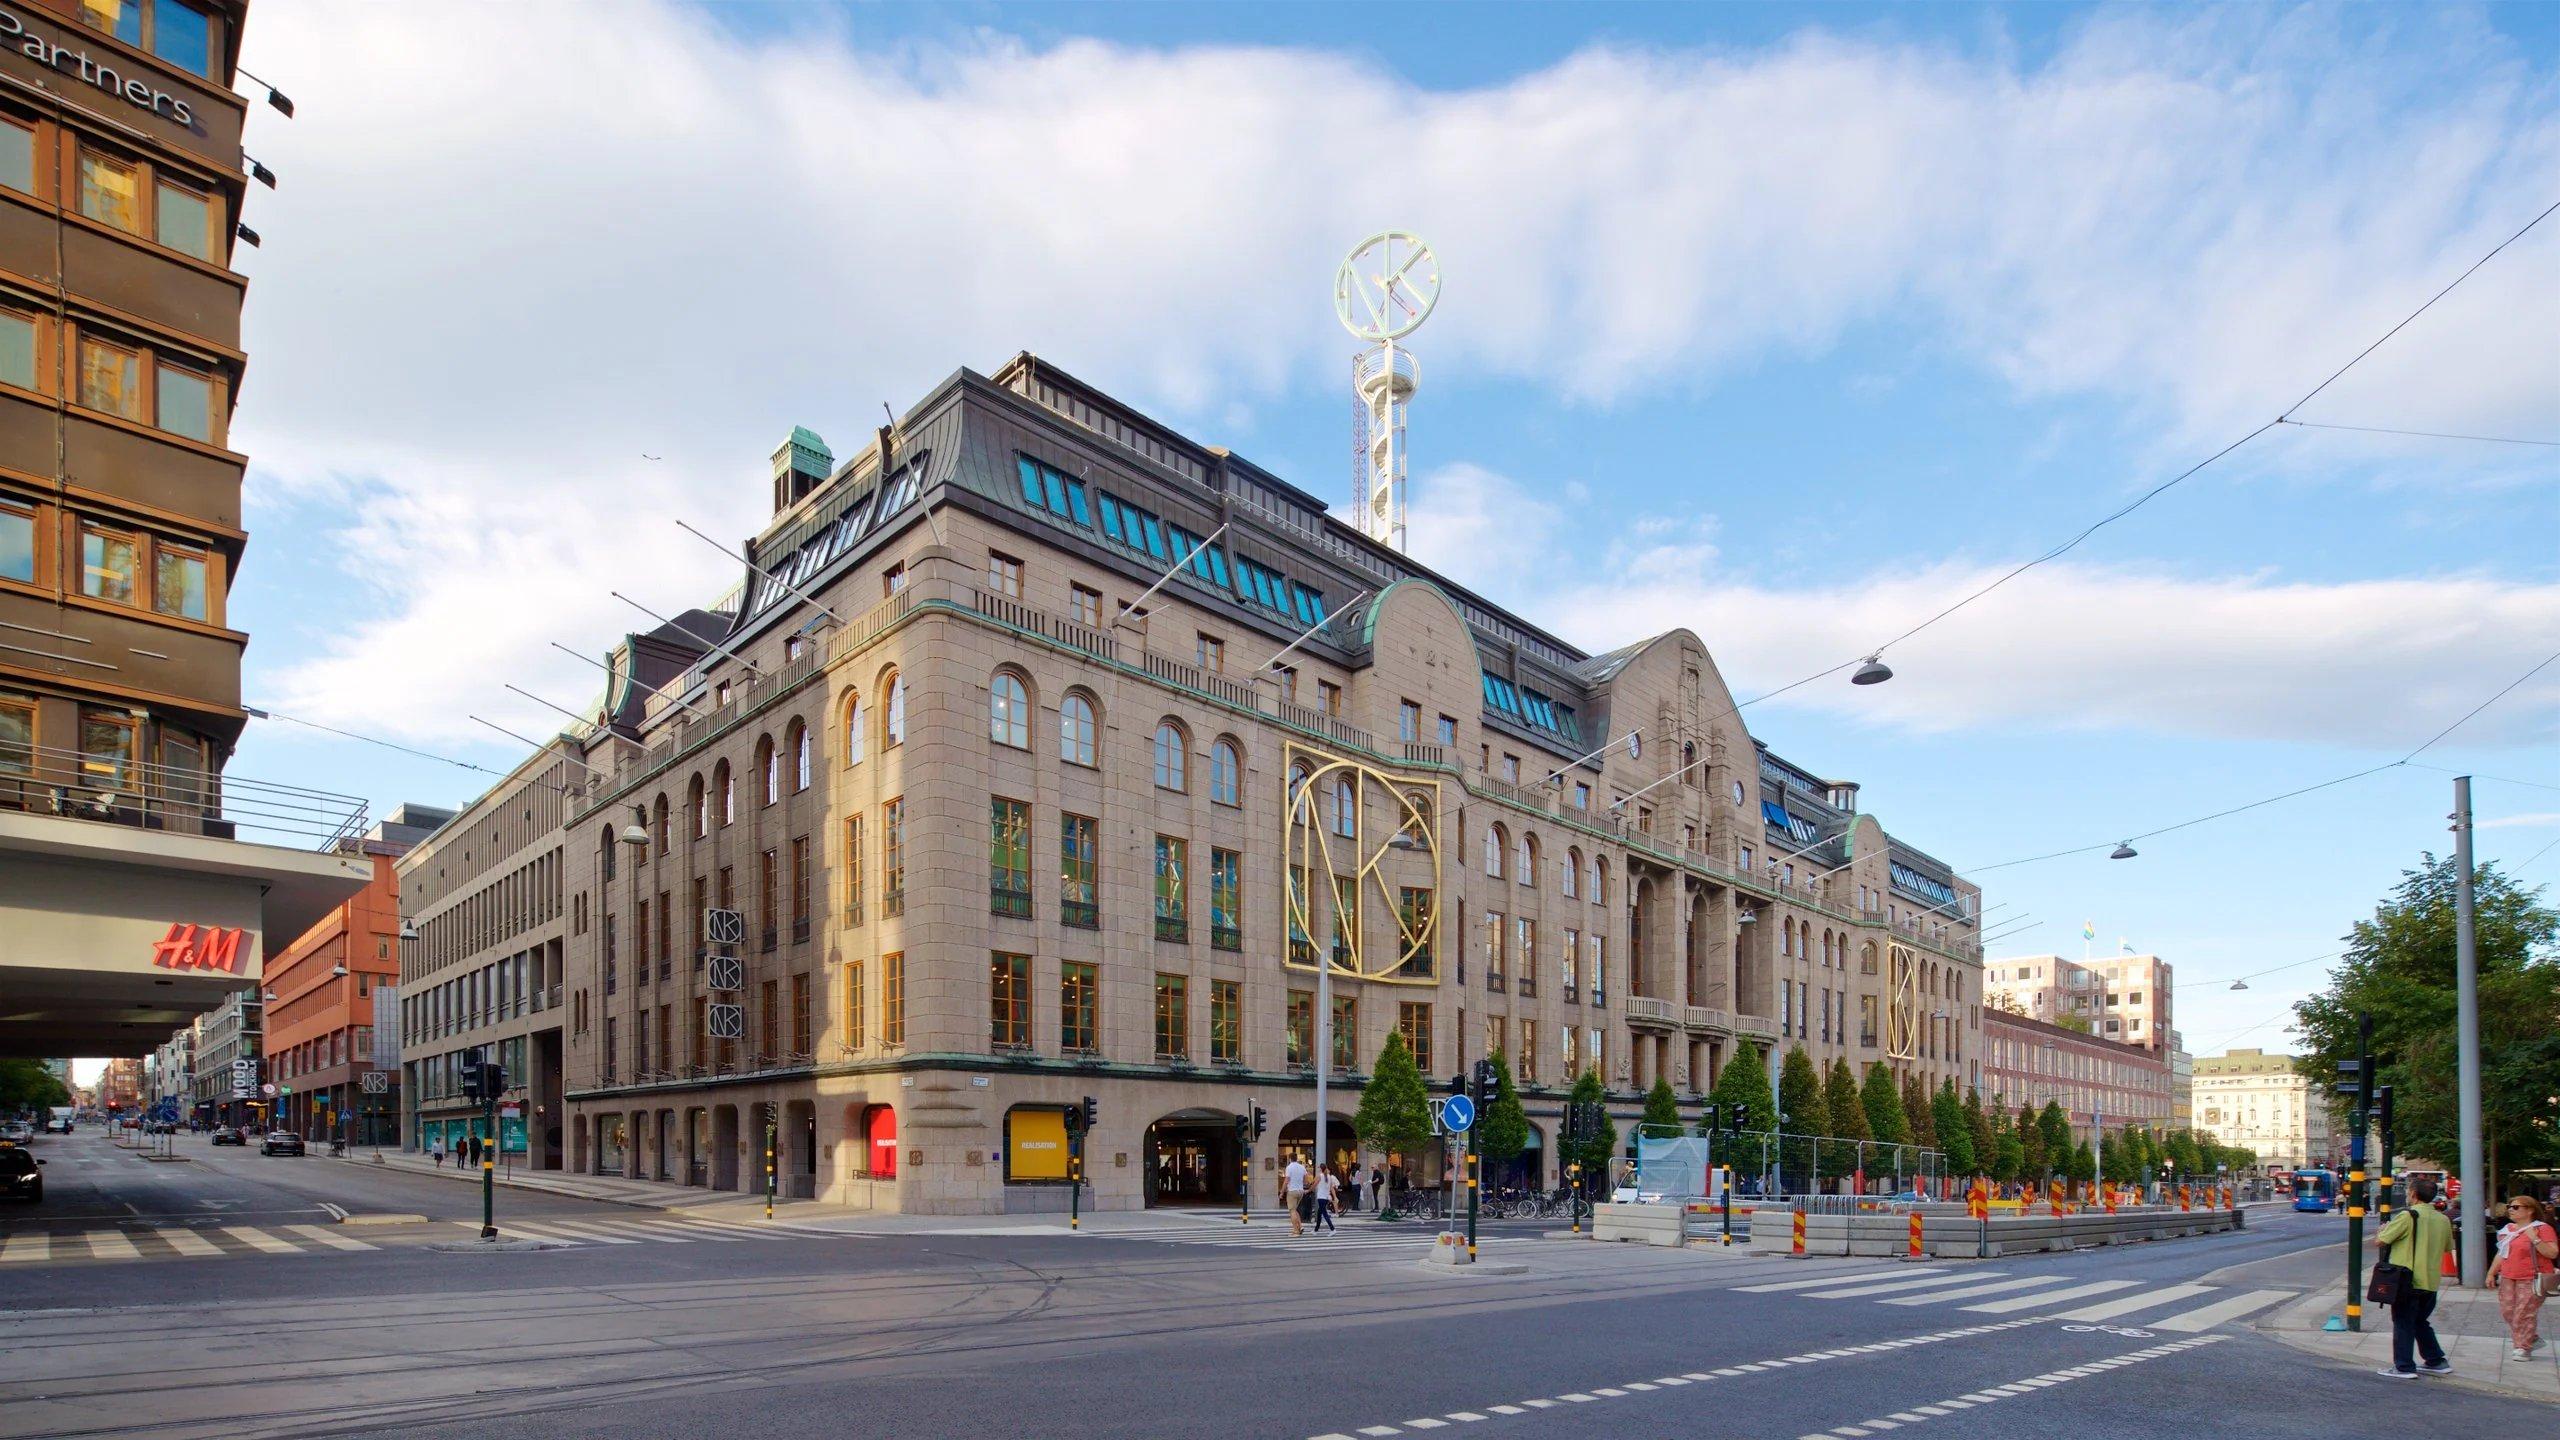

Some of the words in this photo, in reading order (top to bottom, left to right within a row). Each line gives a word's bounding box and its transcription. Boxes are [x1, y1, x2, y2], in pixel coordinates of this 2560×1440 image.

[0, 10, 192, 127] Partners
[1288, 758, 1438, 978] NK
[709, 909, 741, 943] NK
[153, 922, 242, 973] H&M
[709, 957, 741, 990] NK
[709, 1004, 741, 1037] NK
[232, 1059, 249, 1098] MOOD
[249, 1059, 258, 1099] STOCKHOLM
[362, 1072, 387, 1093] NK
